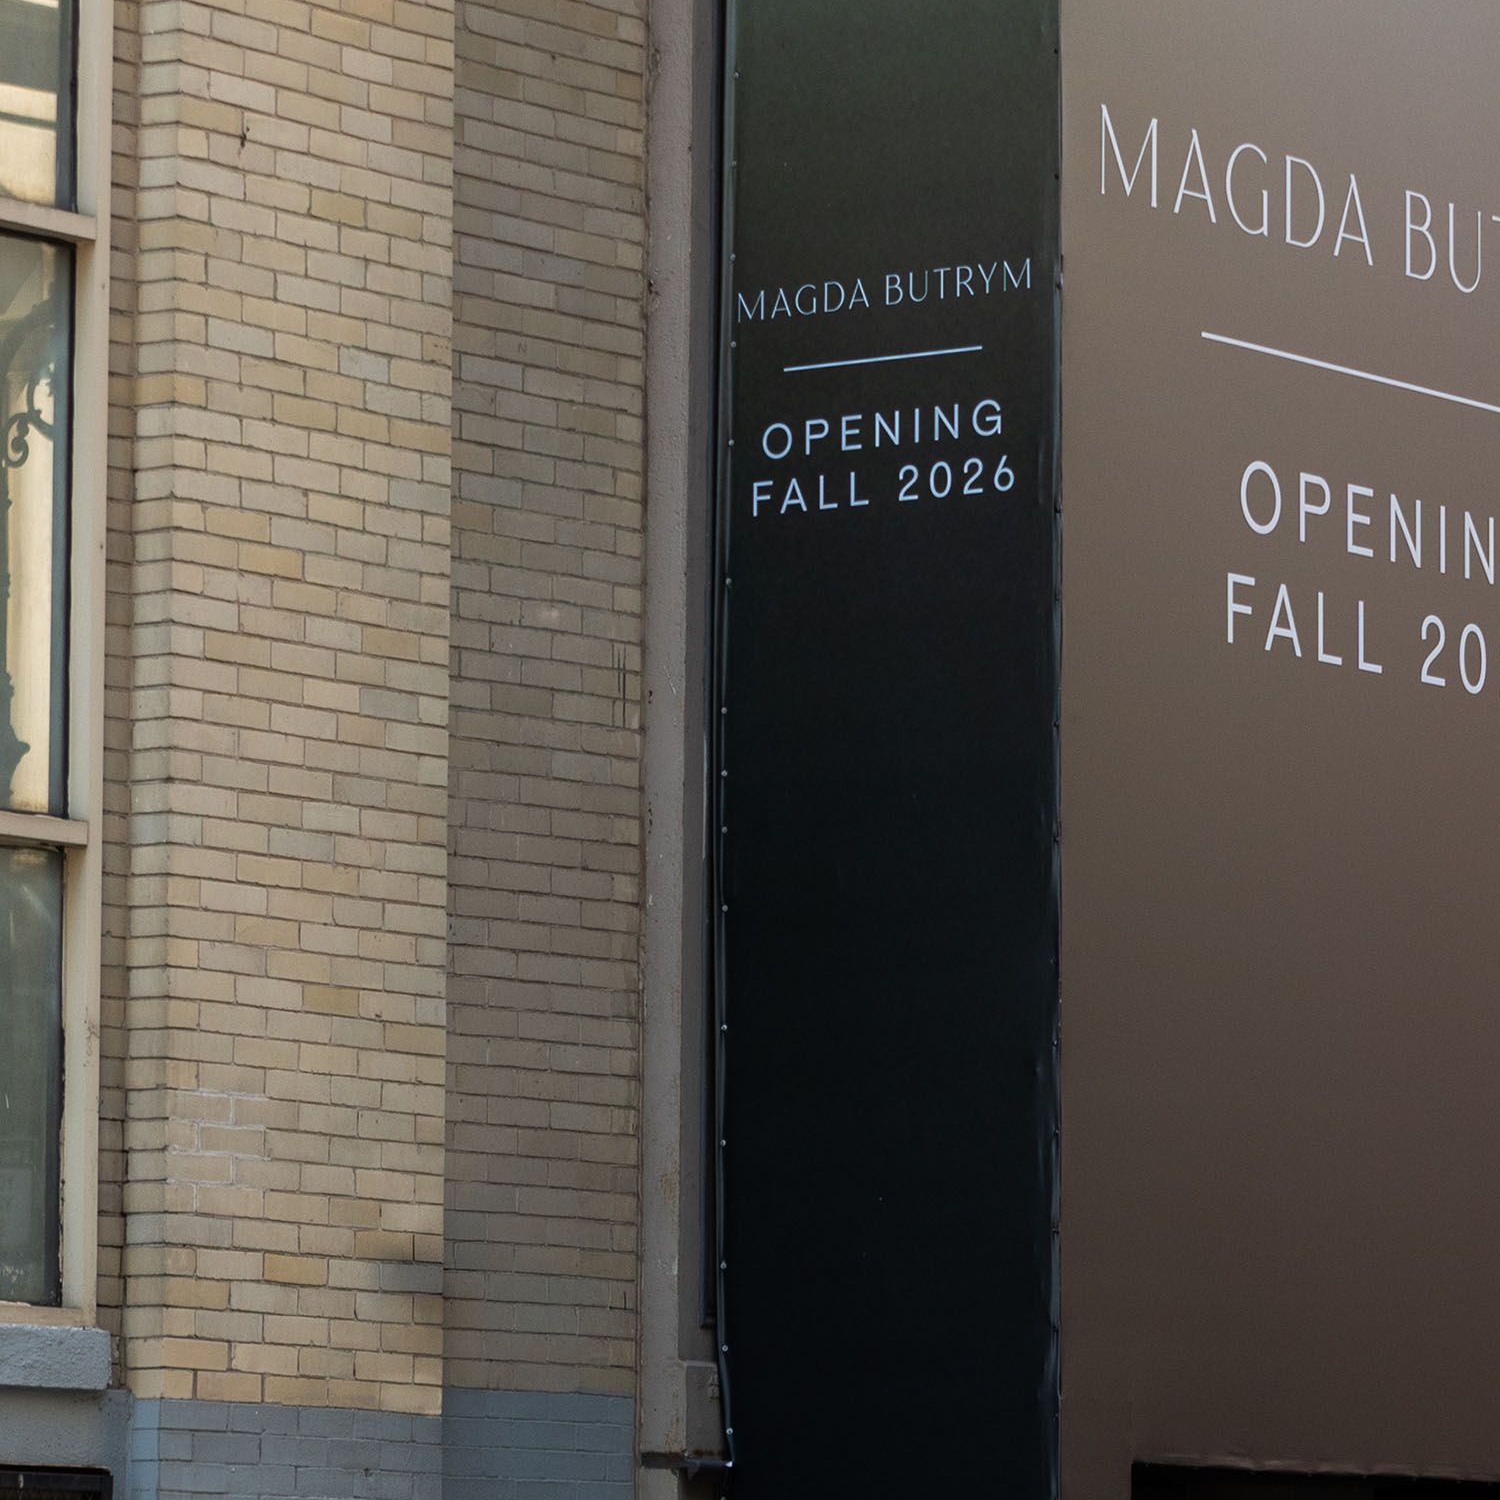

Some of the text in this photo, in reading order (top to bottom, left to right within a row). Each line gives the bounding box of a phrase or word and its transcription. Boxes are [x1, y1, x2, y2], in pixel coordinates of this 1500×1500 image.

[1099, 102, 1373, 266] MAGDA
[737, 258, 1031, 323] MAGDA BUTRYM
[762, 399, 1001, 460] OPENING
[752, 454, 1015, 517] FALL 2026
[1226, 572, 1383, 675] FALL
